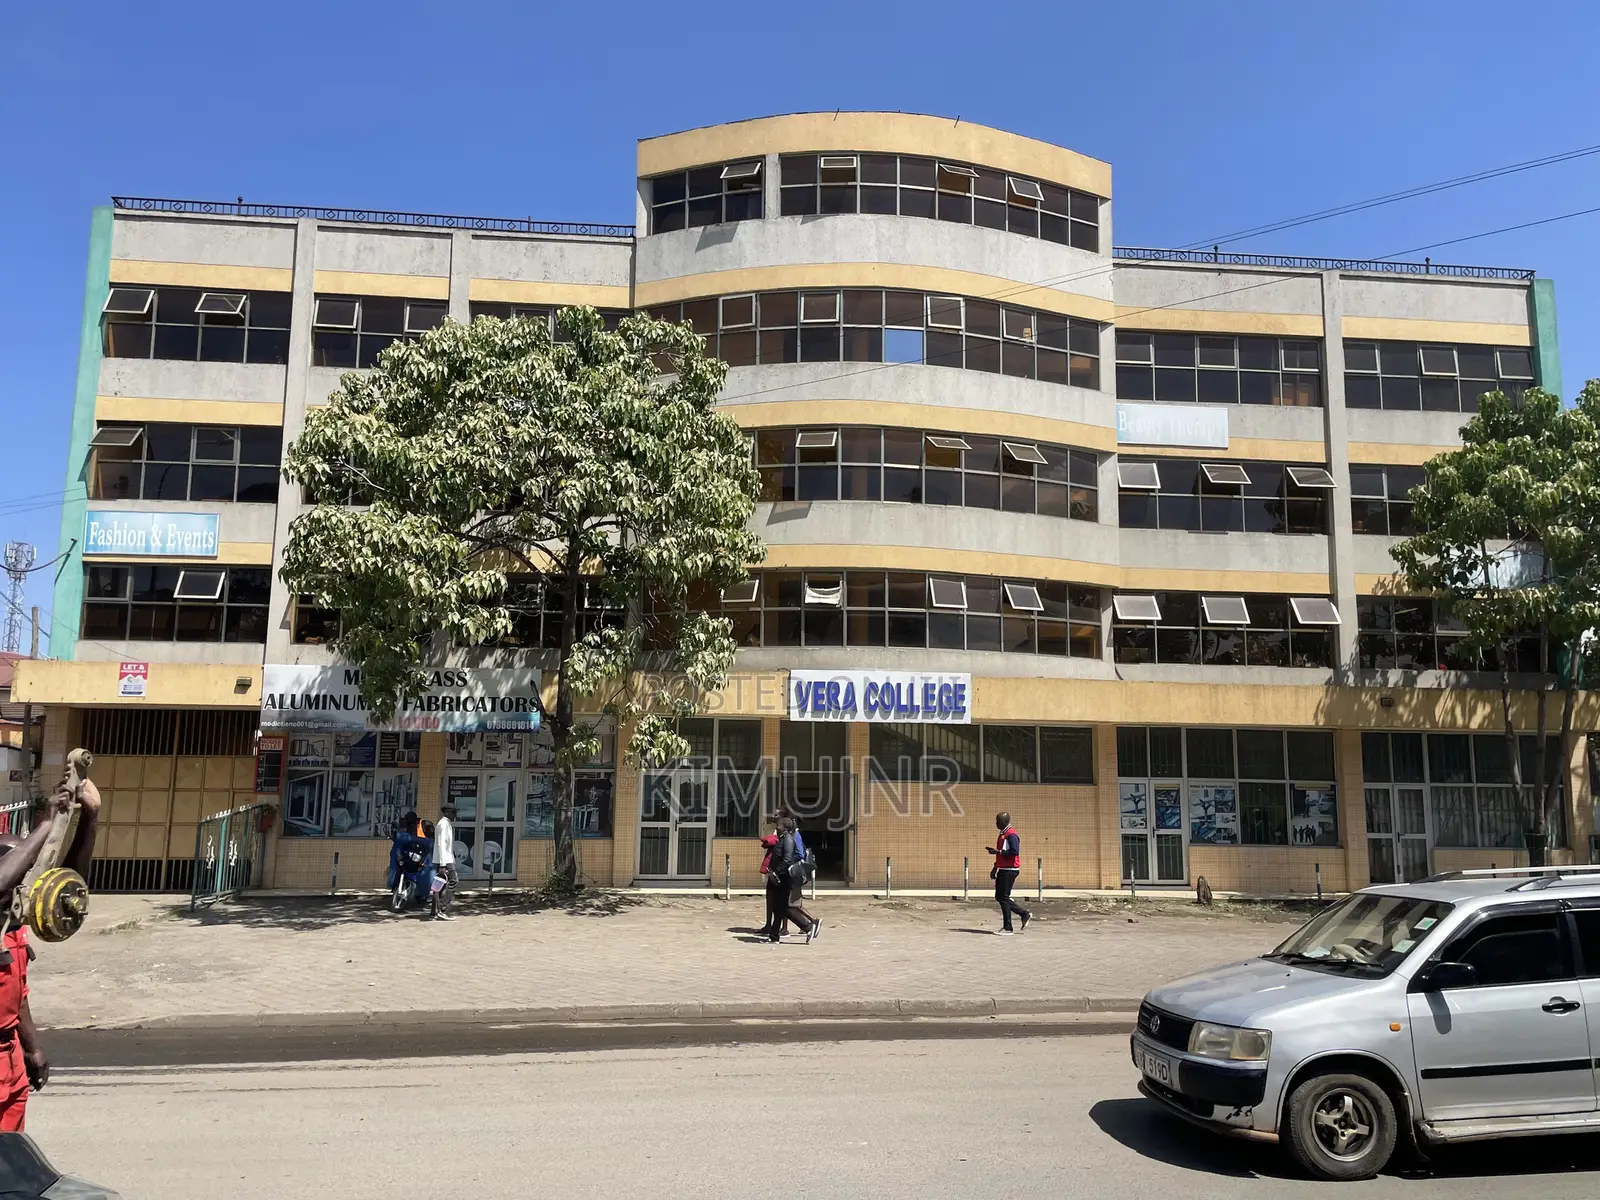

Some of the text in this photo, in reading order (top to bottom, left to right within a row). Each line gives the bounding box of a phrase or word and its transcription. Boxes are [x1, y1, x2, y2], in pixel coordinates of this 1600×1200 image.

[1117, 410, 1223, 443] Beauty Therapy
[89, 521, 215, 549] Fashion & Events
[402, 695, 541, 713] FABRICATORS
[794, 681, 967, 720] VERA COLLEGE
